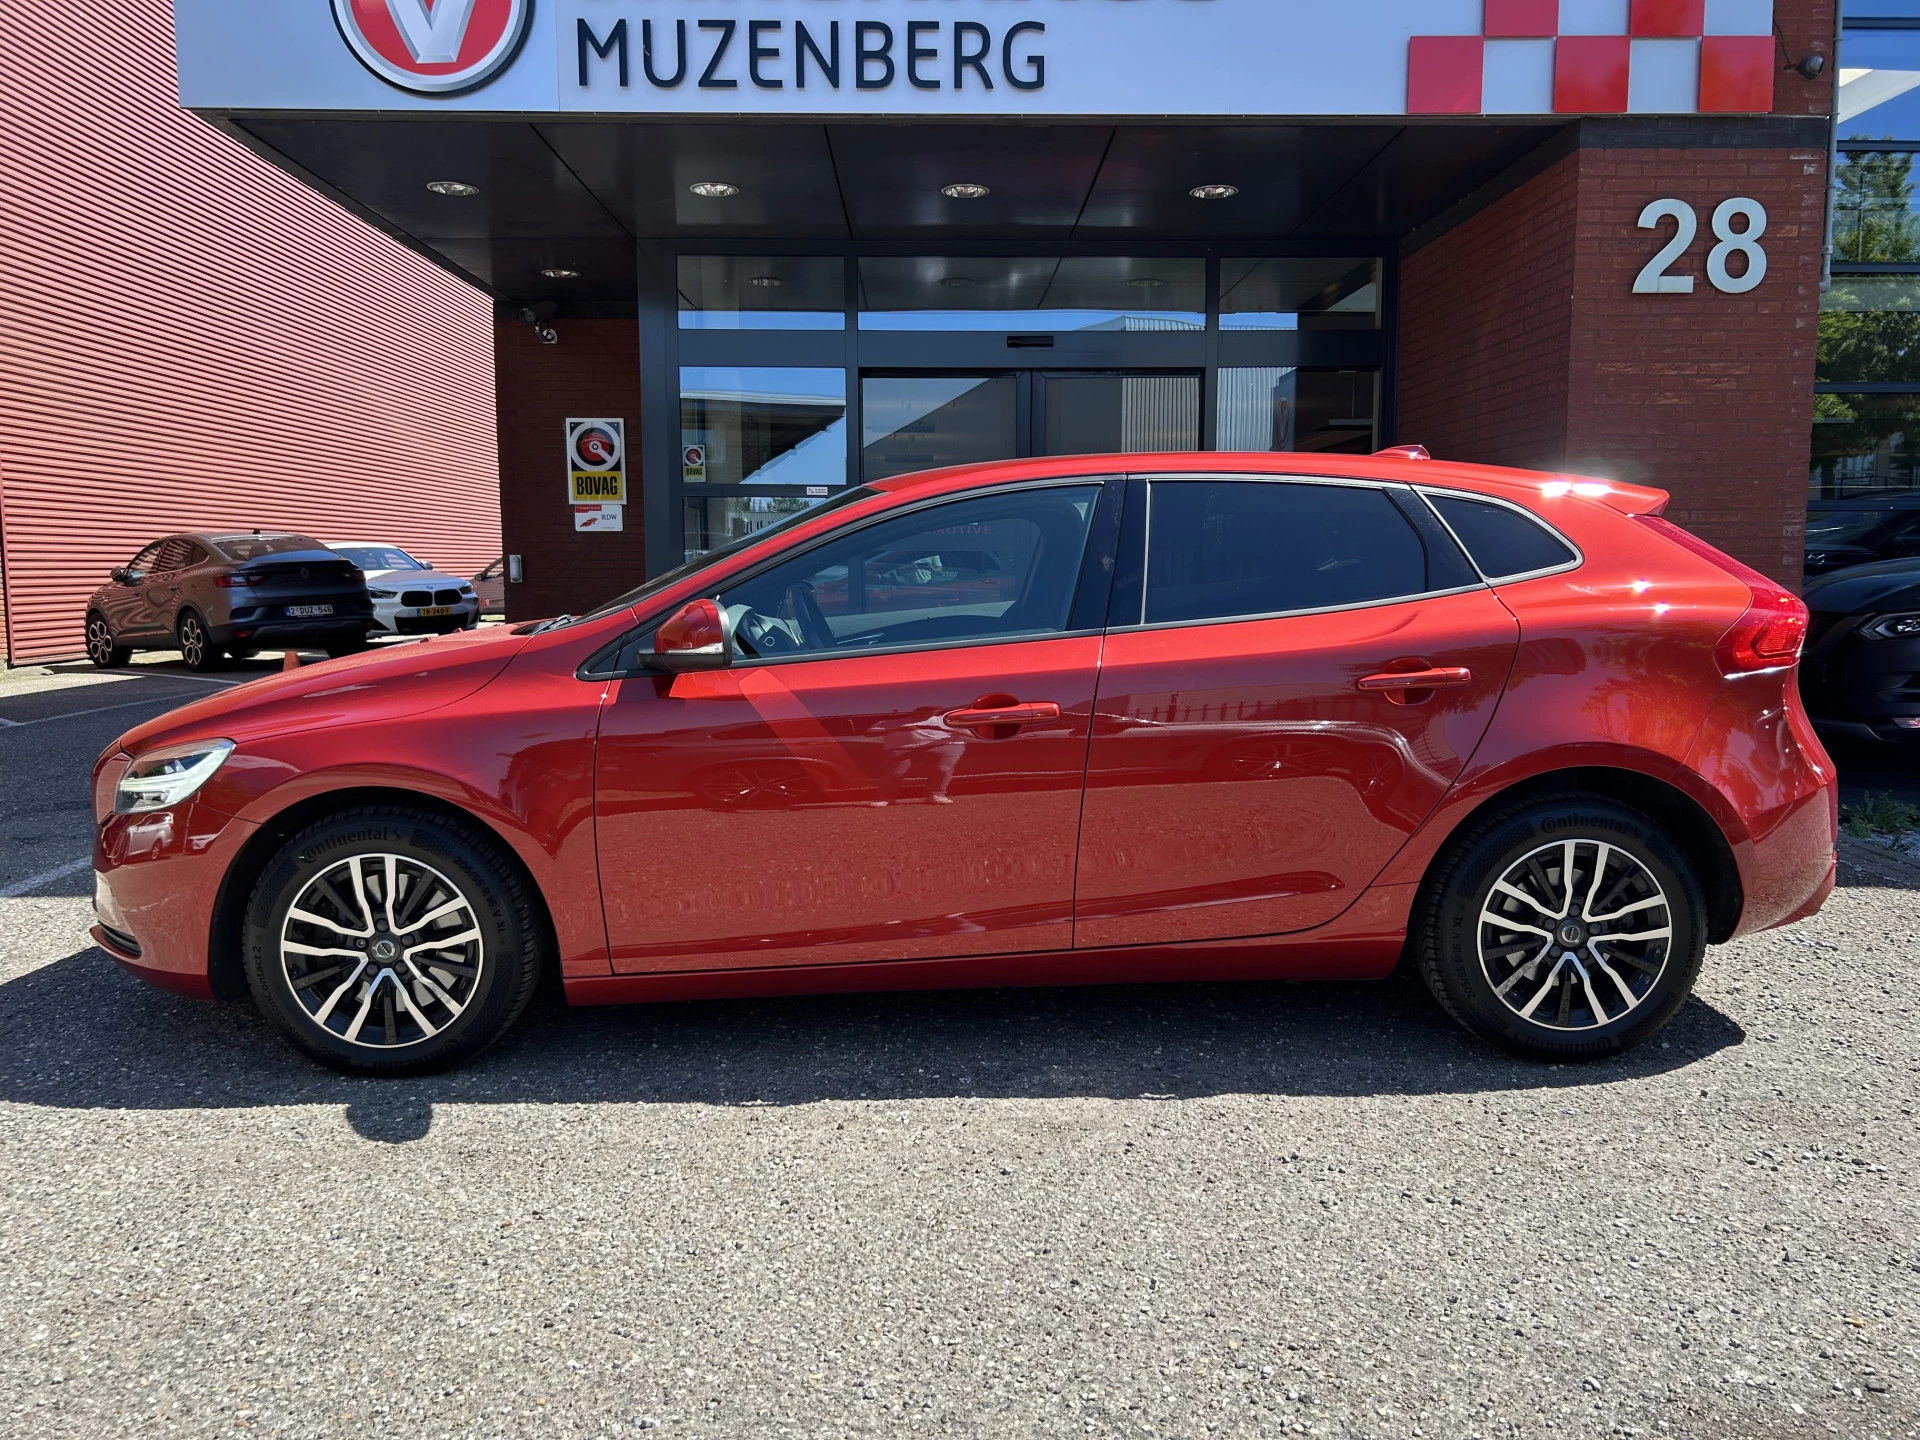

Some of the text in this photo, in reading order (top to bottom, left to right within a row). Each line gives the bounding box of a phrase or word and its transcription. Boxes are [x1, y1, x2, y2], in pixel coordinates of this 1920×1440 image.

[576, 18, 1046, 90] MUZENBERG
[1632, 197, 1767, 294] 28
[576, 476, 618, 495] BOVAG
[686, 468, 702, 476] BOVAG
[1541, 812, 1629, 835] Continental
[303, 827, 388, 863] Continental
[454, 856, 485, 887] 205/55
